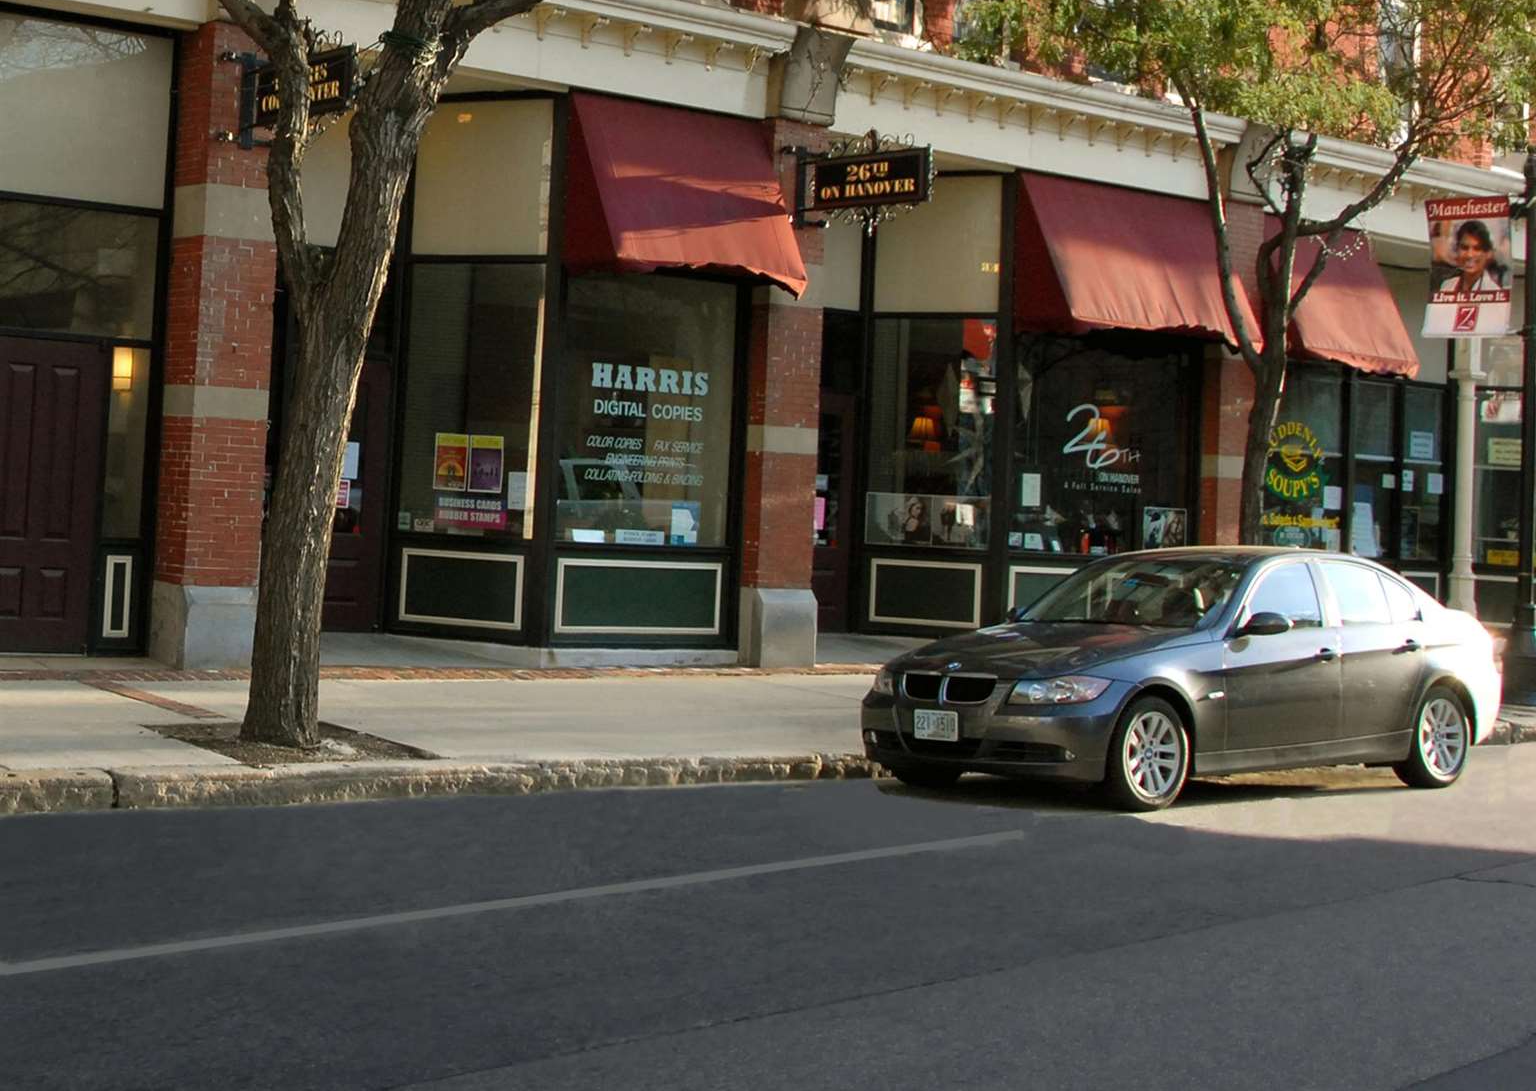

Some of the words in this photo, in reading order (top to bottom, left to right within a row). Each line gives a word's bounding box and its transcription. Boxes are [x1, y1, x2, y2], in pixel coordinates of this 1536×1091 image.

[846, 161, 889, 182] 26TH
[820, 186, 840, 200] ON
[845, 178, 915, 197] HANOVER
[1429, 198, 1508, 217] Manchester
[1433, 292, 1455, 302] Live
[1456, 291, 1468, 302] it.
[1470, 292, 1494, 302] Love
[591, 362, 709, 397] HARRIS
[594, 399, 646, 418] DIGITAL
[651, 404, 703, 422] COPIES
[586, 435, 613, 448] COLOR
[614, 437, 643, 450] COPIES
[672, 440, 704, 454] SERVICE
[1266, 467, 1320, 498] SOUPY'S
